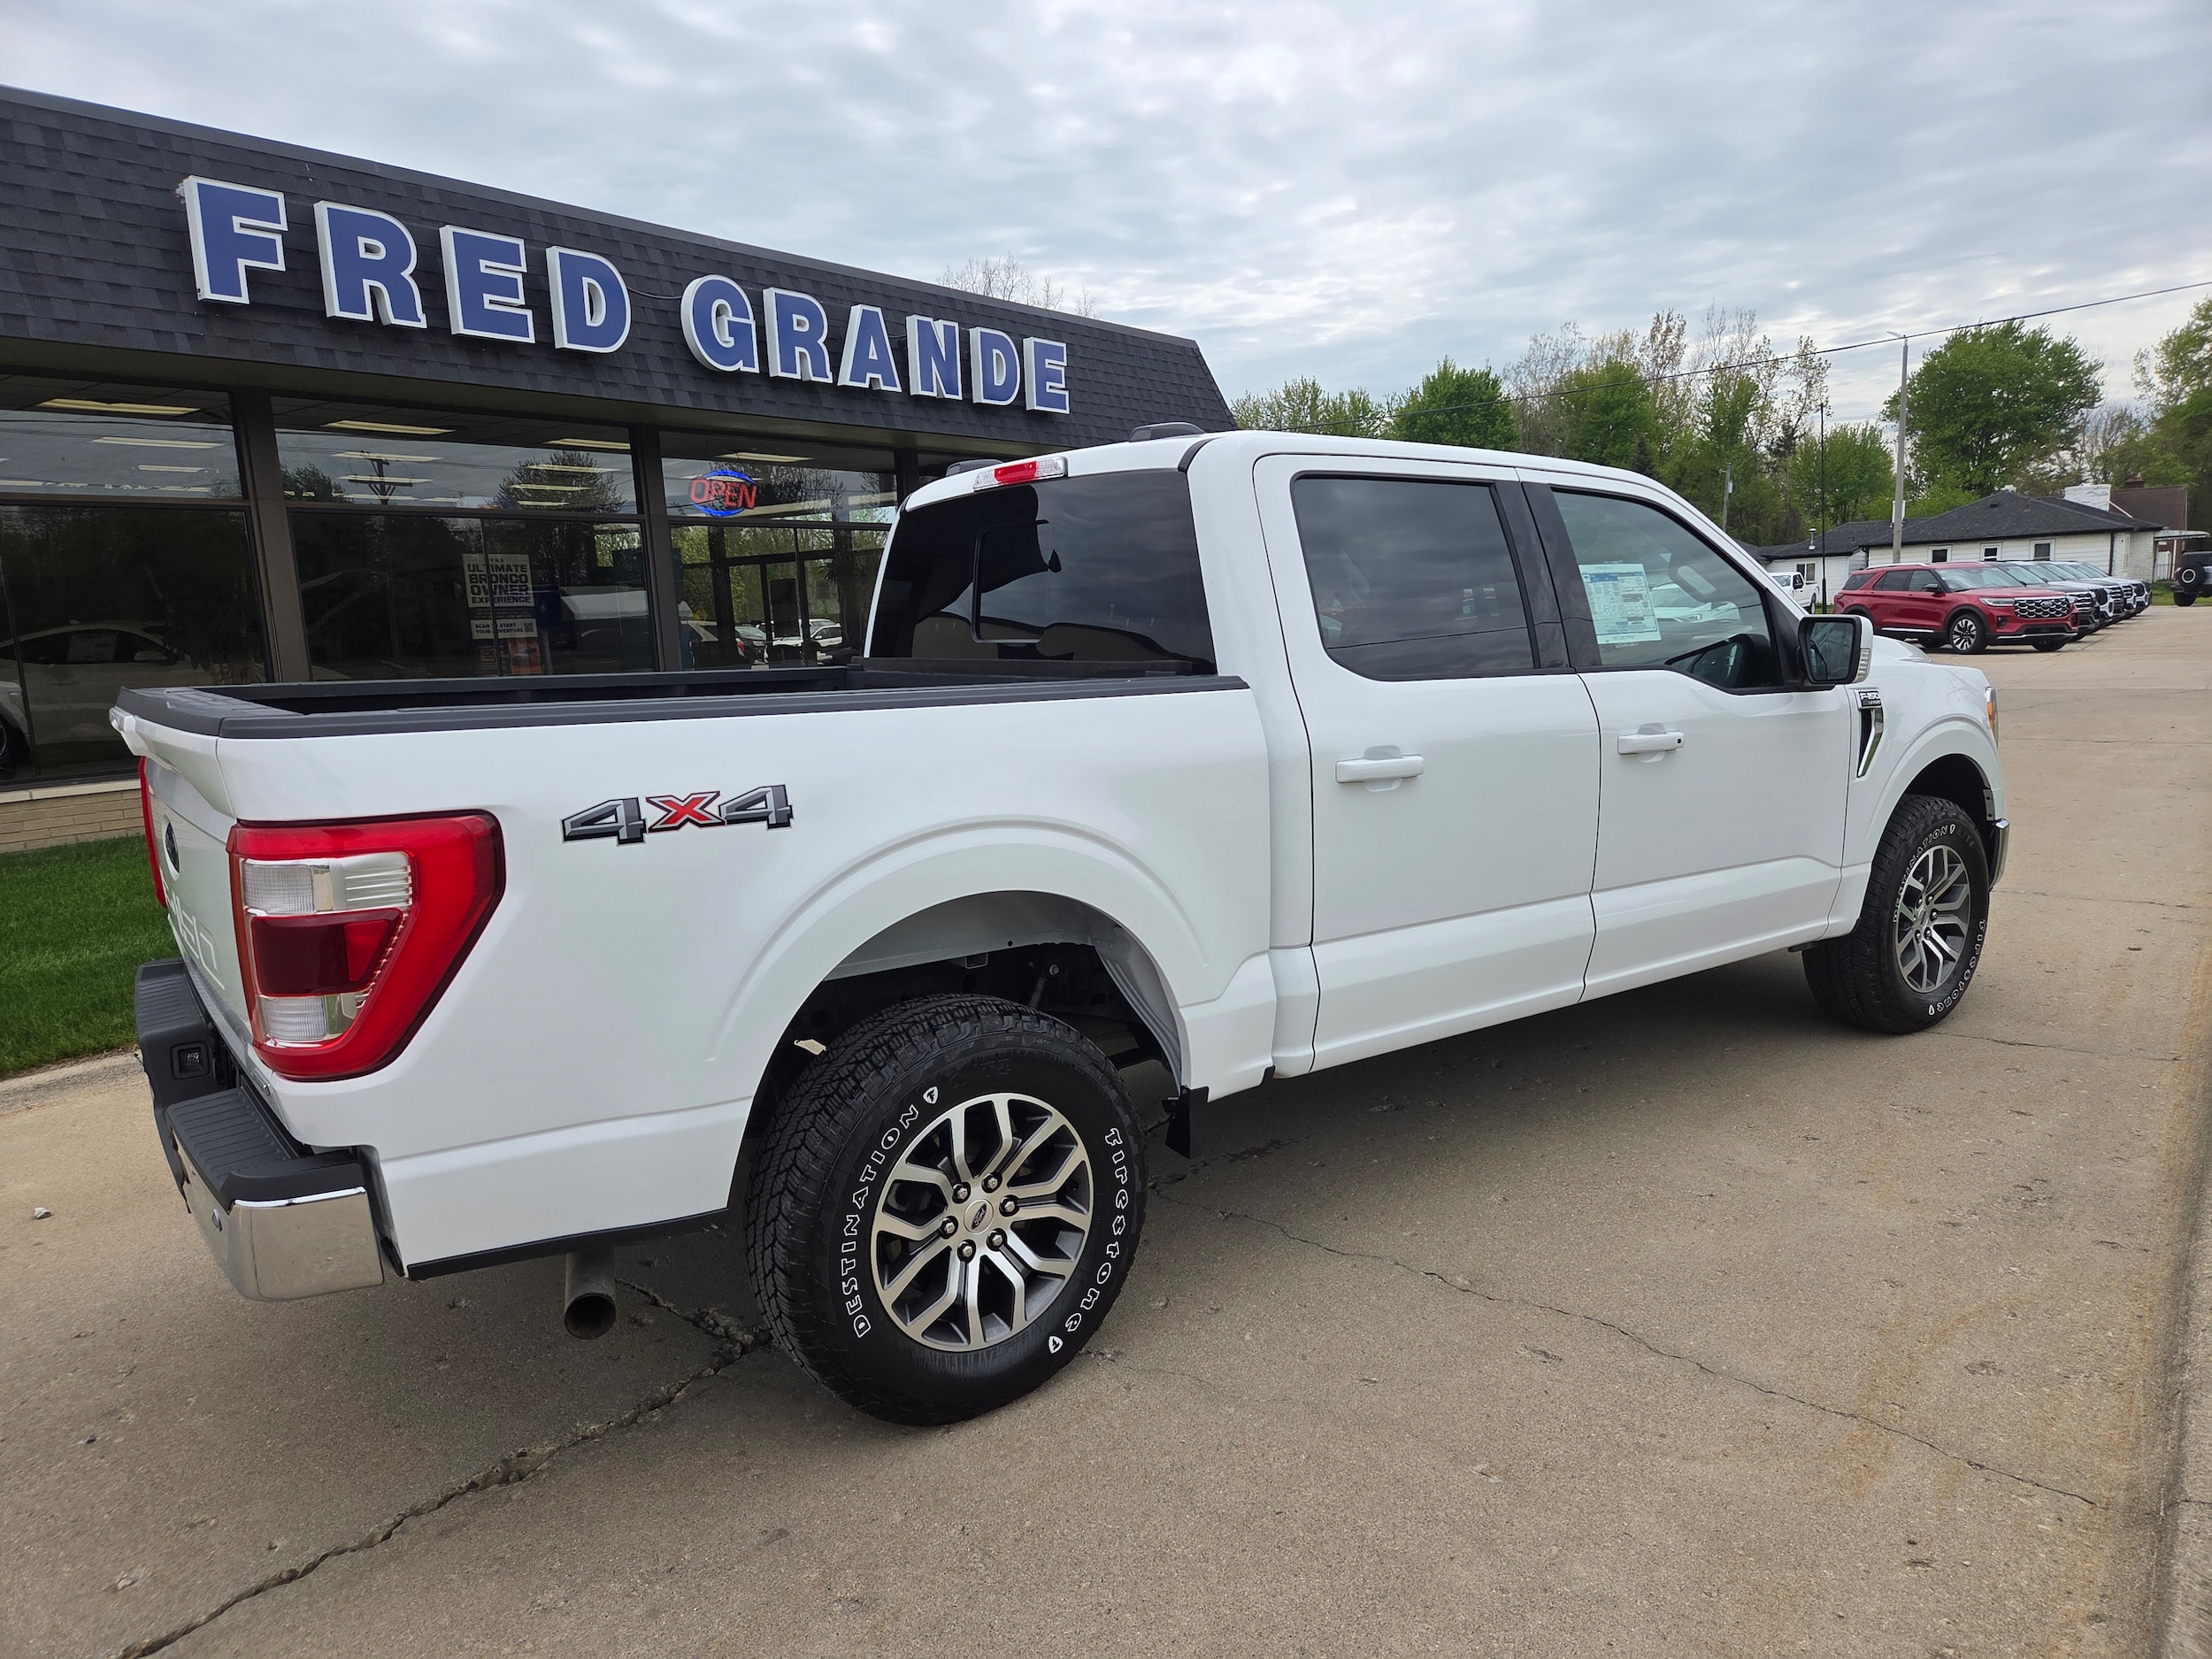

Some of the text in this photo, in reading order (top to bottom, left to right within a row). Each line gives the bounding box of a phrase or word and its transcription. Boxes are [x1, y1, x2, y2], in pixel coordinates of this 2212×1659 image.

[183, 175, 1071, 415] FRED GRANDE
[689, 476, 757, 510] OPEN
[841, 1104, 919, 1338] DESTINATION
